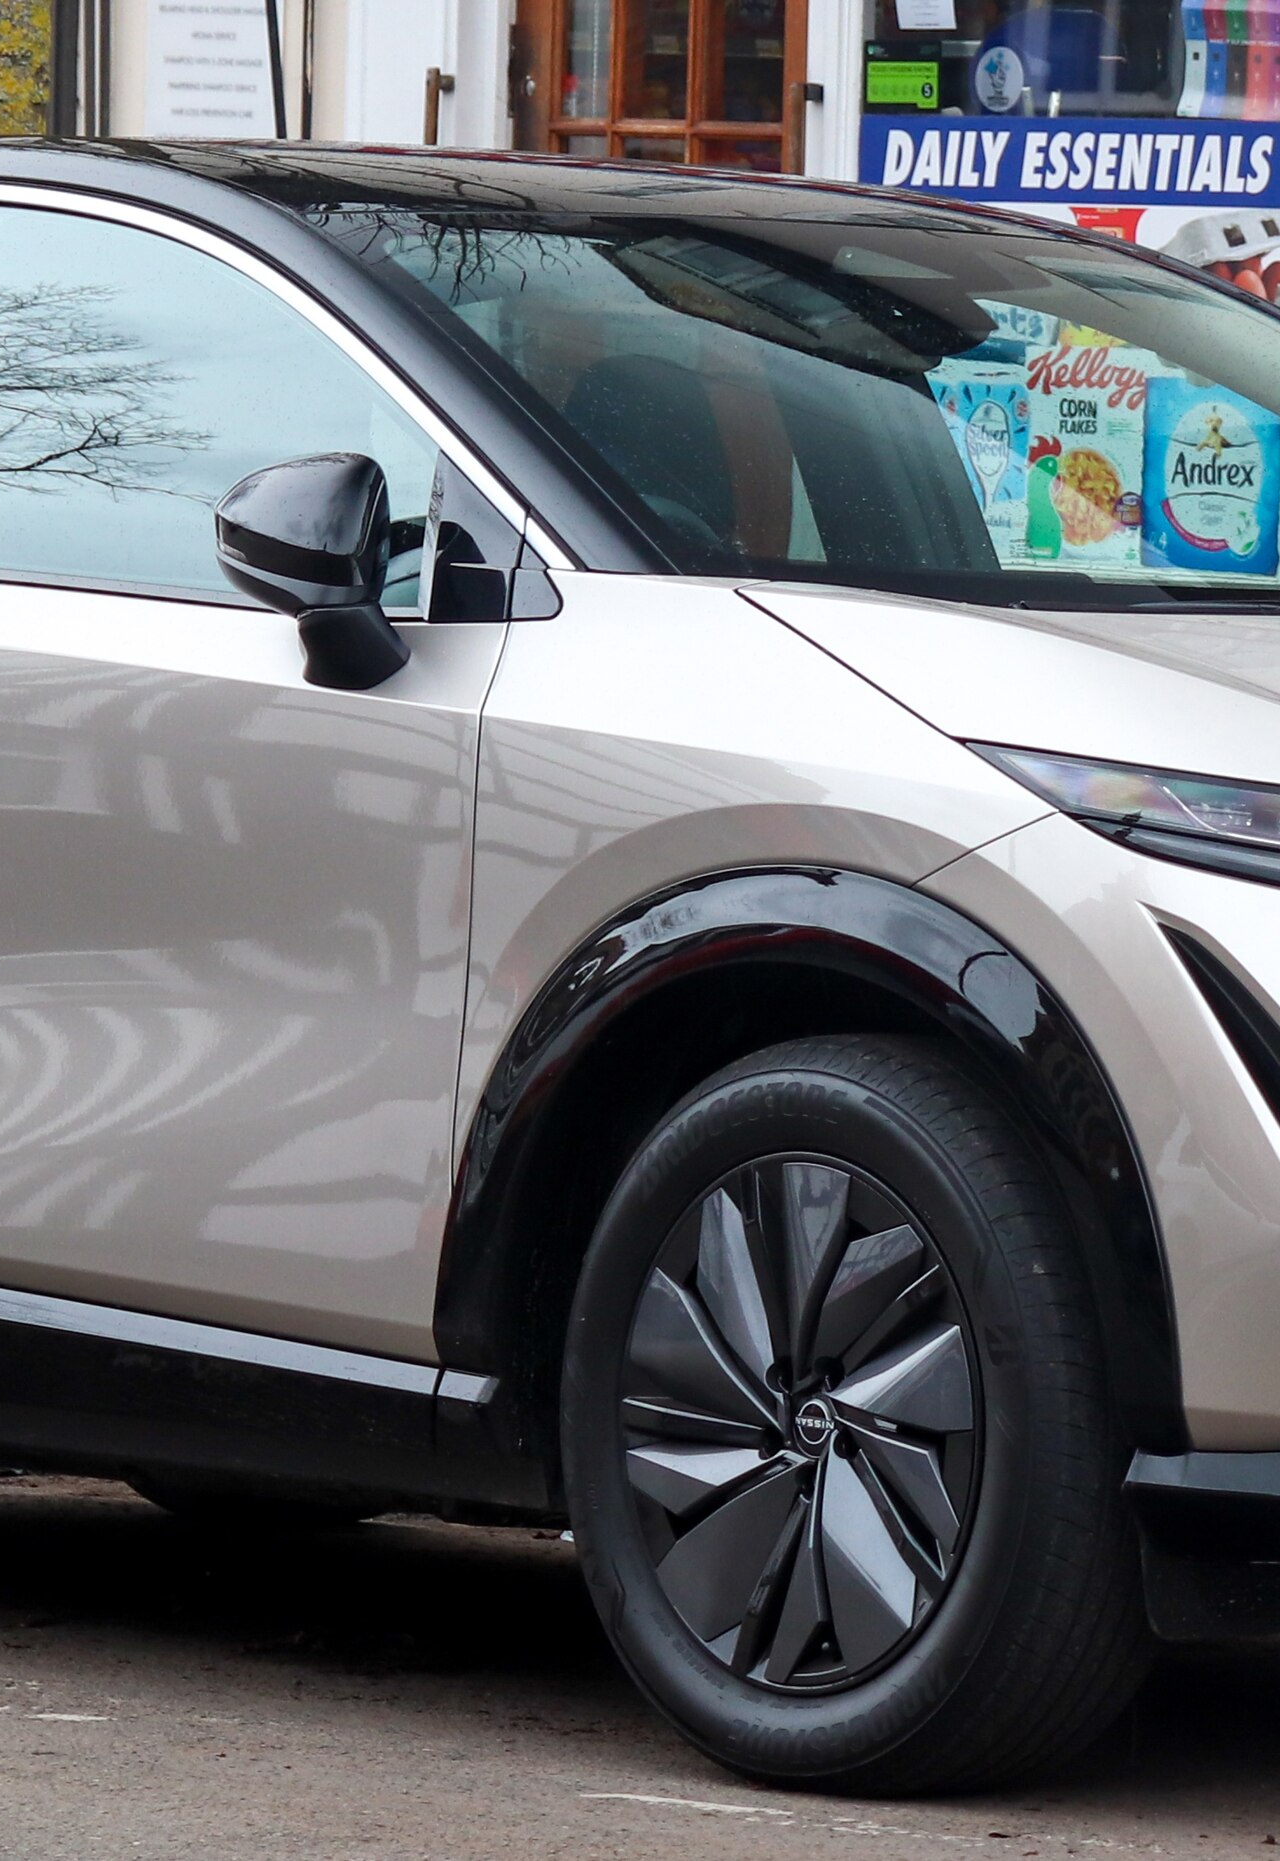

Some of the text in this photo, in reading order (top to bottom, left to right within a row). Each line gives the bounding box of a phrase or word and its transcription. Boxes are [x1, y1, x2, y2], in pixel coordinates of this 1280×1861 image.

[923, 84, 932, 97] 5
[882, 130, 1275, 195] DAILY ESSENTIALS
[1059, 398, 1098, 419] CORN
[968, 423, 1009, 442] Silver
[1059, 419, 1098, 435] FLAKES
[969, 440, 1009, 462] Spoon
[1171, 452, 1256, 488] Andrex
[795, 1416, 835, 1430] NISSAN
